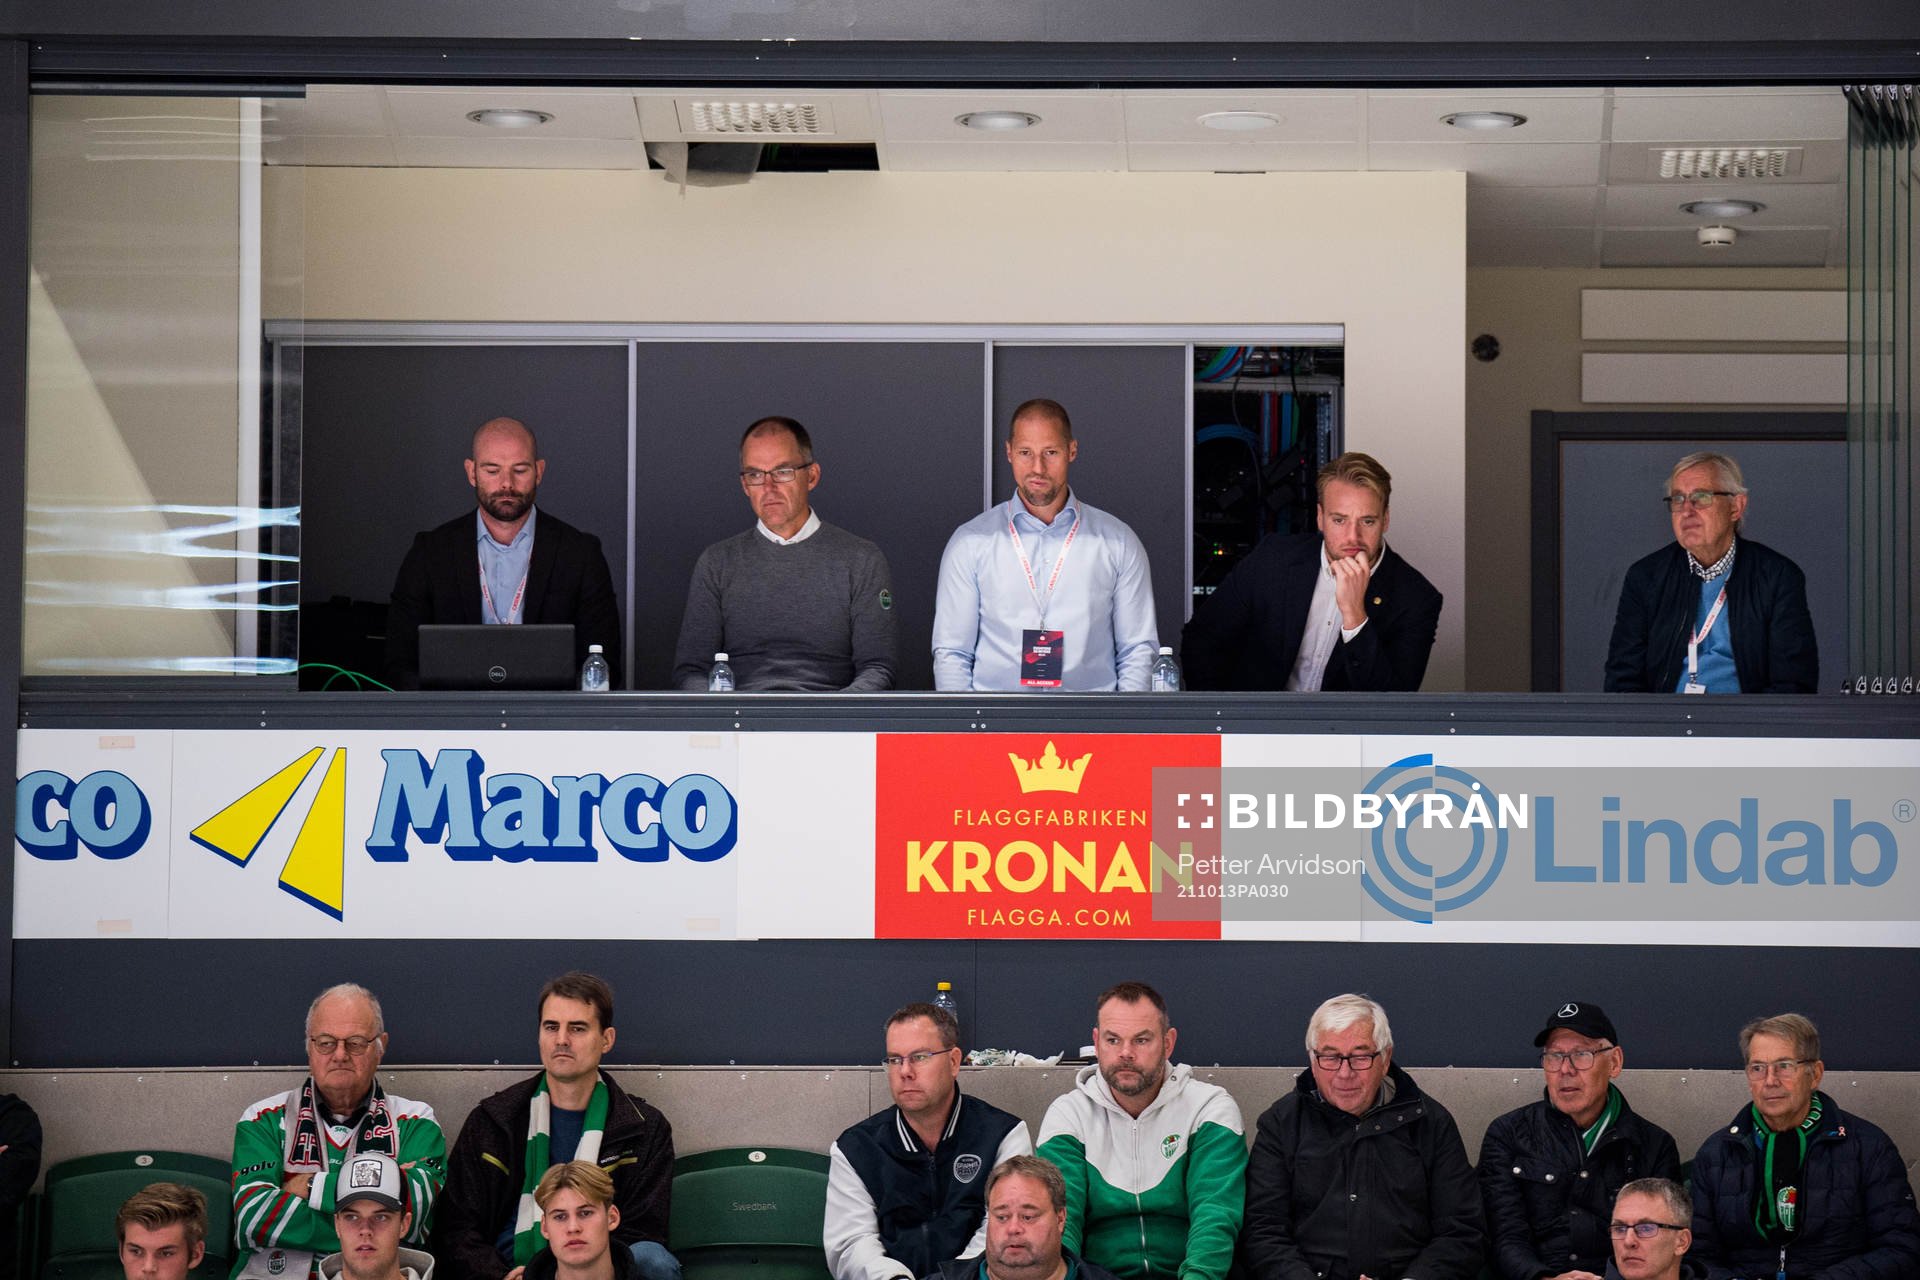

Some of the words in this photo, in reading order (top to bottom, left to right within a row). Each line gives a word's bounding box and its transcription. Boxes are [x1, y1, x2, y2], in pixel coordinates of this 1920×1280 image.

[365, 748, 738, 863] Marco
[954, 809, 1147, 826] FLAGGFABRIKEN
[1535, 796, 1898, 887] Lindab
[906, 840, 1193, 893] KRONAN
[967, 909, 1131, 926] FLAGGA.COM
[732, 1201, 777, 1211] Swedbank
